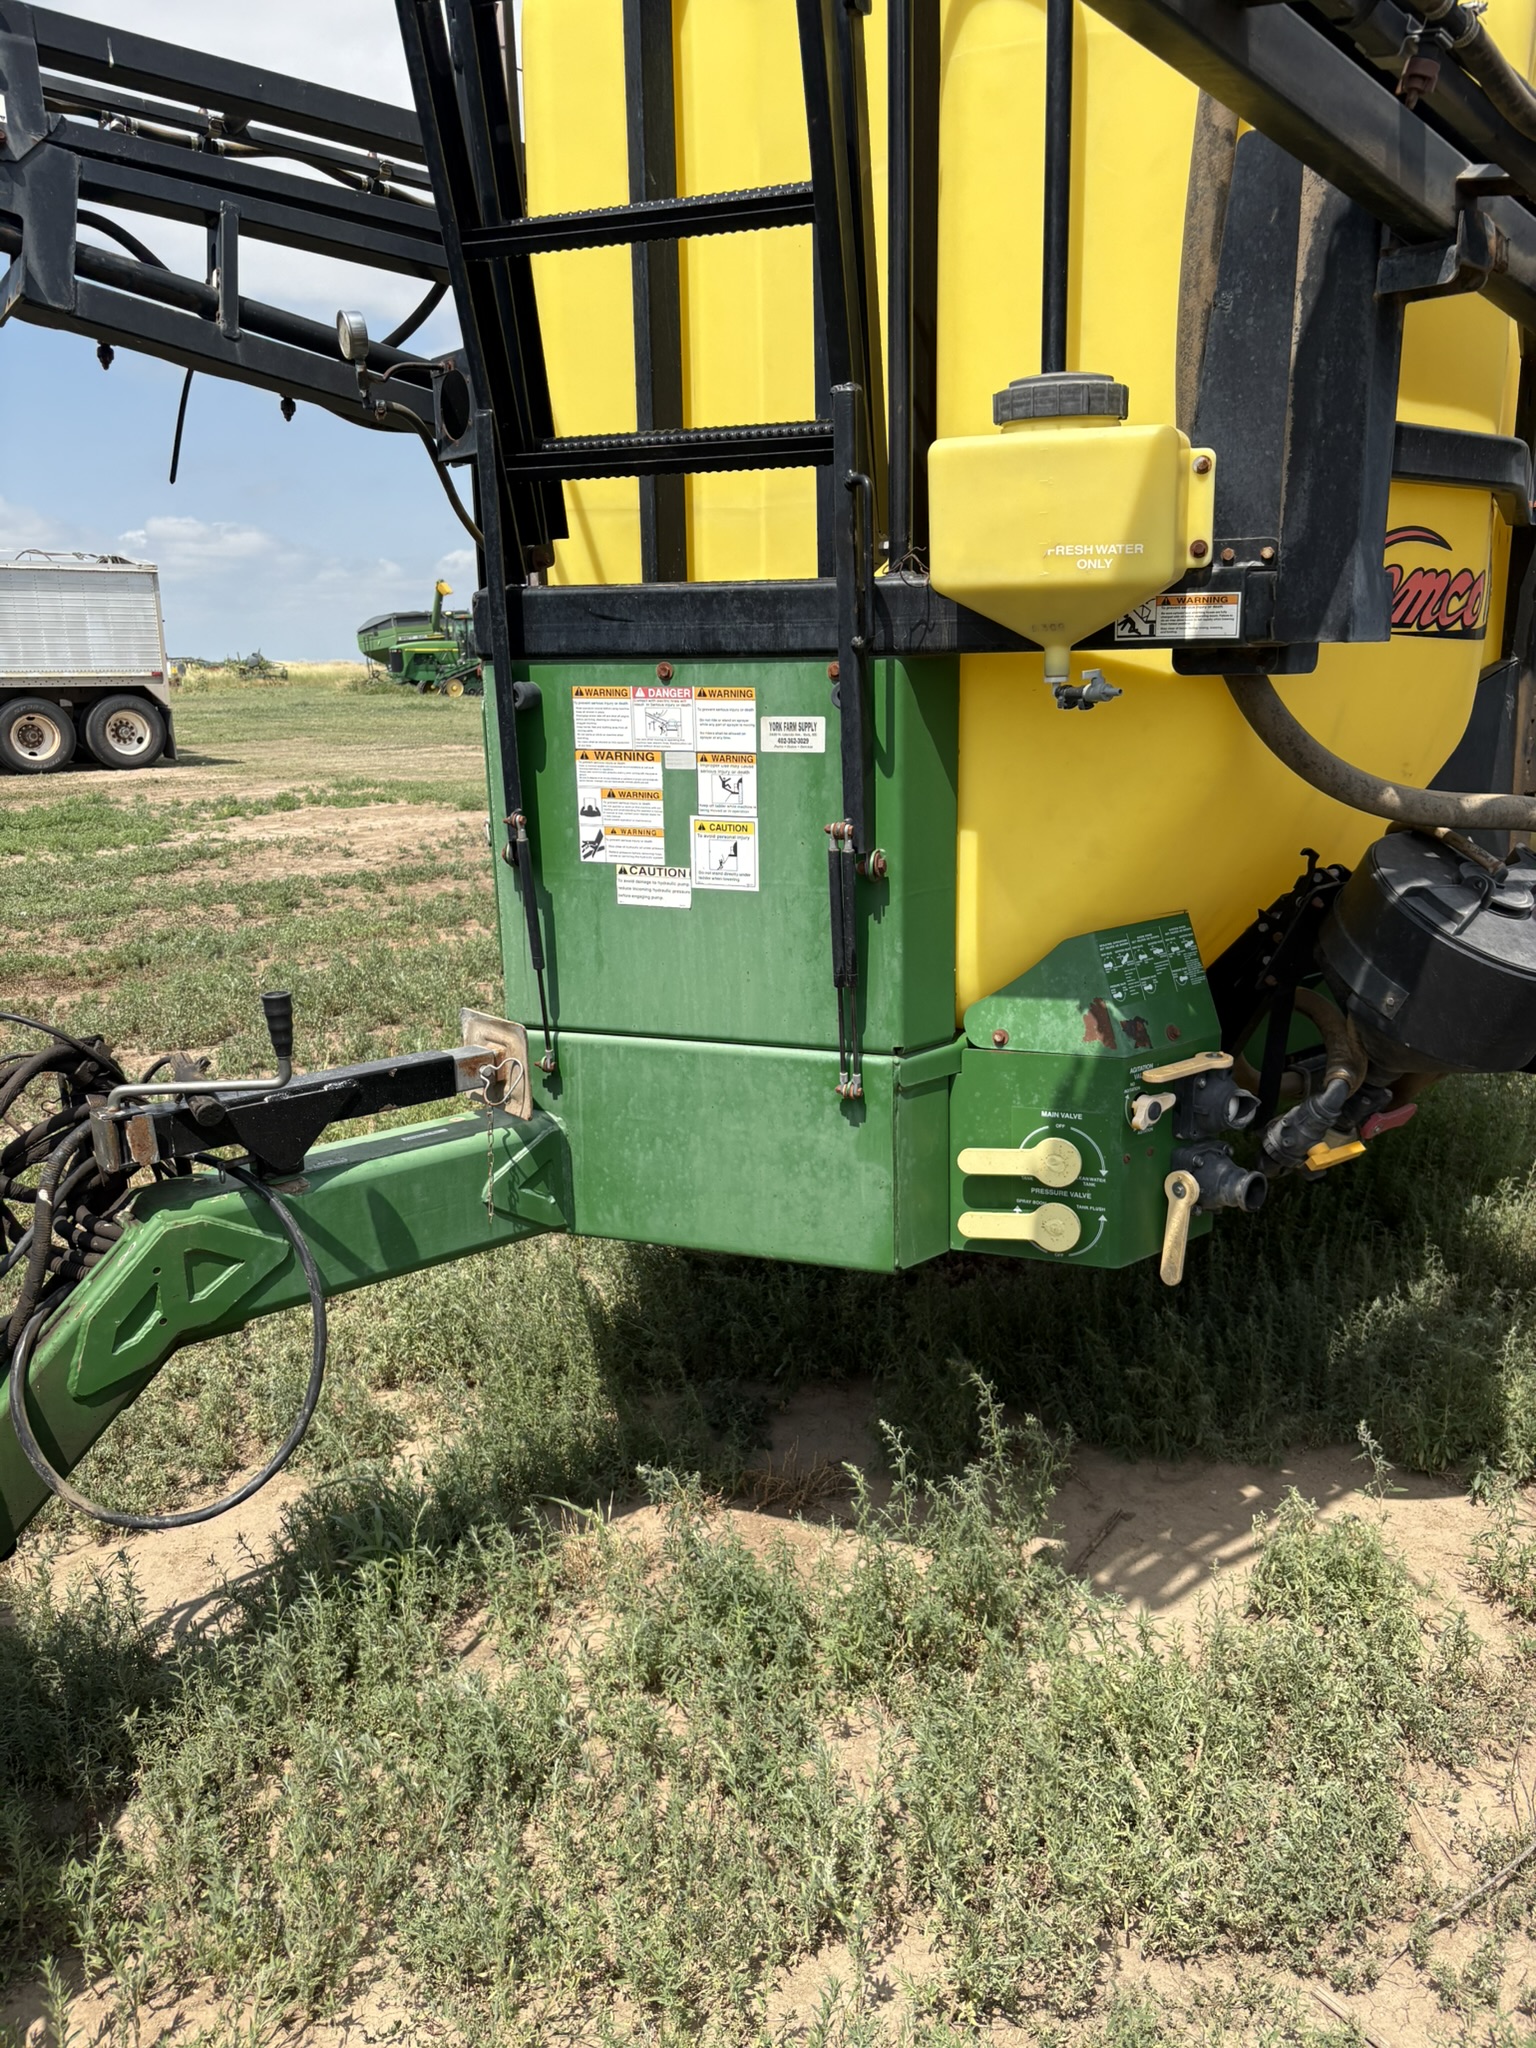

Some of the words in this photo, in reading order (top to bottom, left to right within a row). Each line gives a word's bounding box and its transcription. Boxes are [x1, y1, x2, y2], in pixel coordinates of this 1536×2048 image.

[1095, 543, 1144, 555] WATER
[1076, 558, 1113, 570] ONLY
[1176, 596, 1229, 604] WARNING
[585, 688, 628, 698] WARNING
[648, 688, 691, 698] DANGER
[708, 689, 753, 698] WARNING
[769, 721, 782, 732] YORK
[783, 721, 797, 732] FARM
[798, 721, 818, 732] SUPPLY
[594, 751, 655, 762] WARNING
[711, 754, 754, 764] WARNING
[618, 790, 660, 800] WARNING
[620, 828, 657, 837] WARNING
[709, 823, 748, 833] CAUTION
[629, 865, 686, 878] CAUTION
[1129, 1063, 1154, 1075] AGITATION
[1041, 1110, 1059, 1118] MAIN
[1060, 1112, 1083, 1120] VALVE
[1030, 1187, 1069, 1198] PRESSURE
[1070, 1191, 1092, 1200] VALVE
